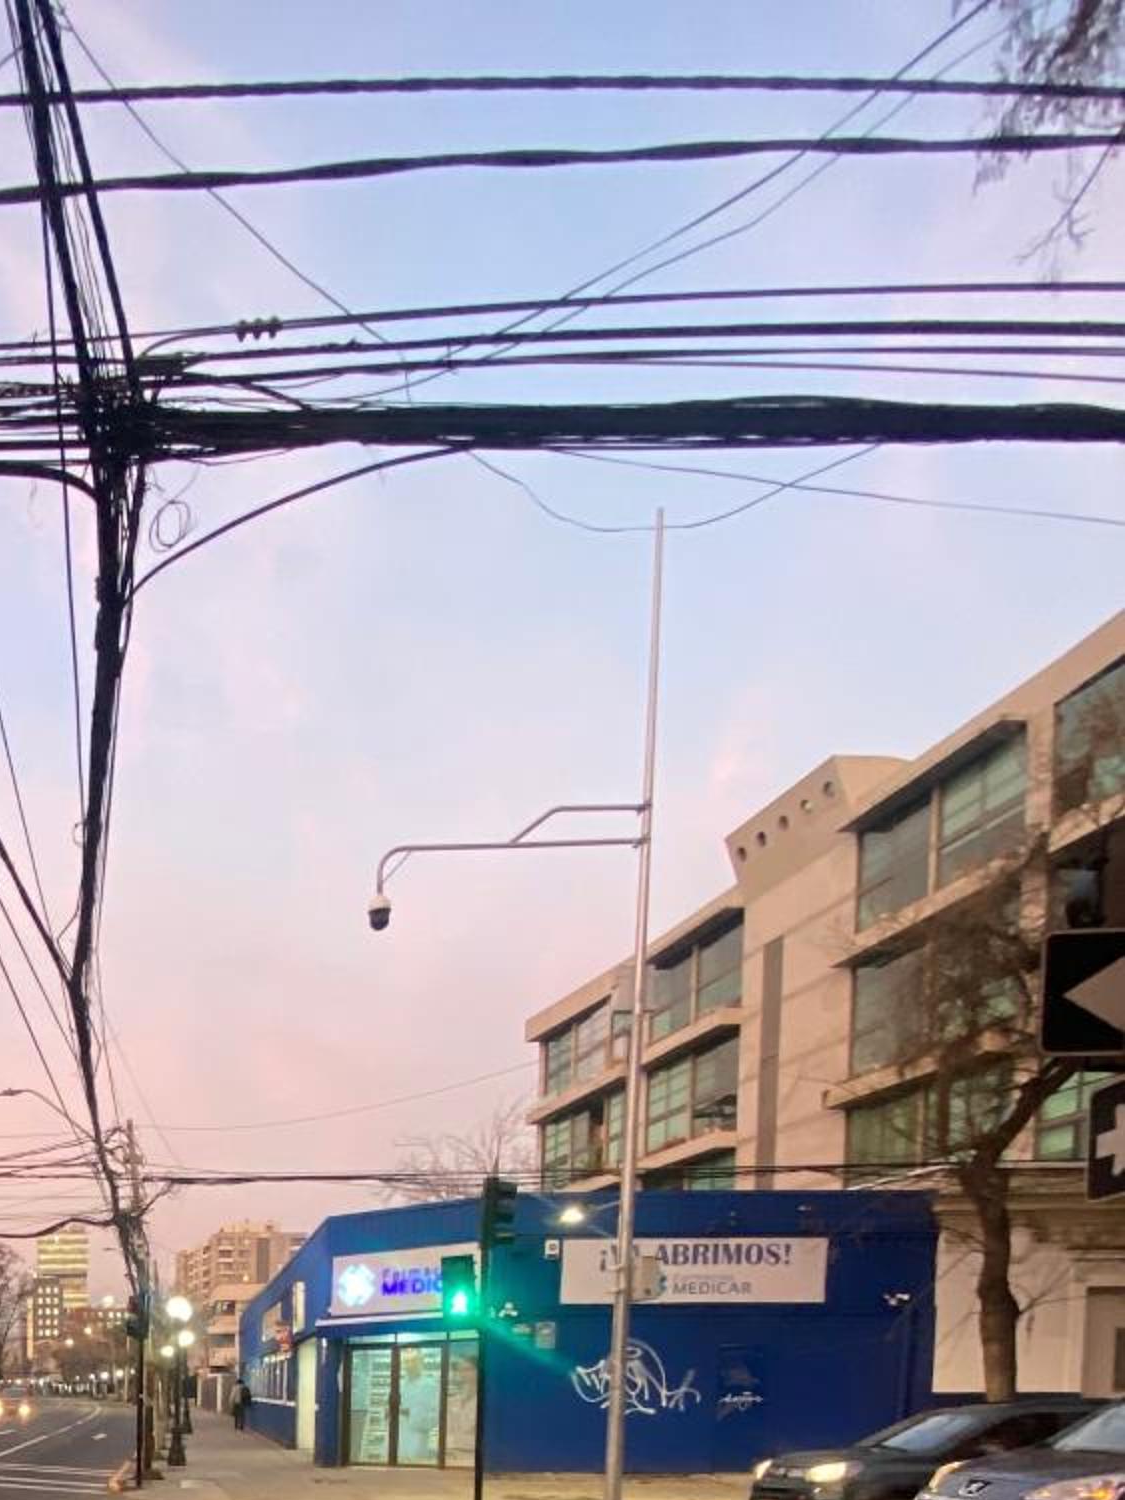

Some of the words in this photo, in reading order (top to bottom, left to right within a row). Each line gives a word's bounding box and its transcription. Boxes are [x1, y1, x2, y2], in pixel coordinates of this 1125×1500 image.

[655, 1243, 792, 1265] ABRIMOS!
[382, 1278, 443, 1296] MEDIC
[672, 1281, 752, 1295] MEDICAR
